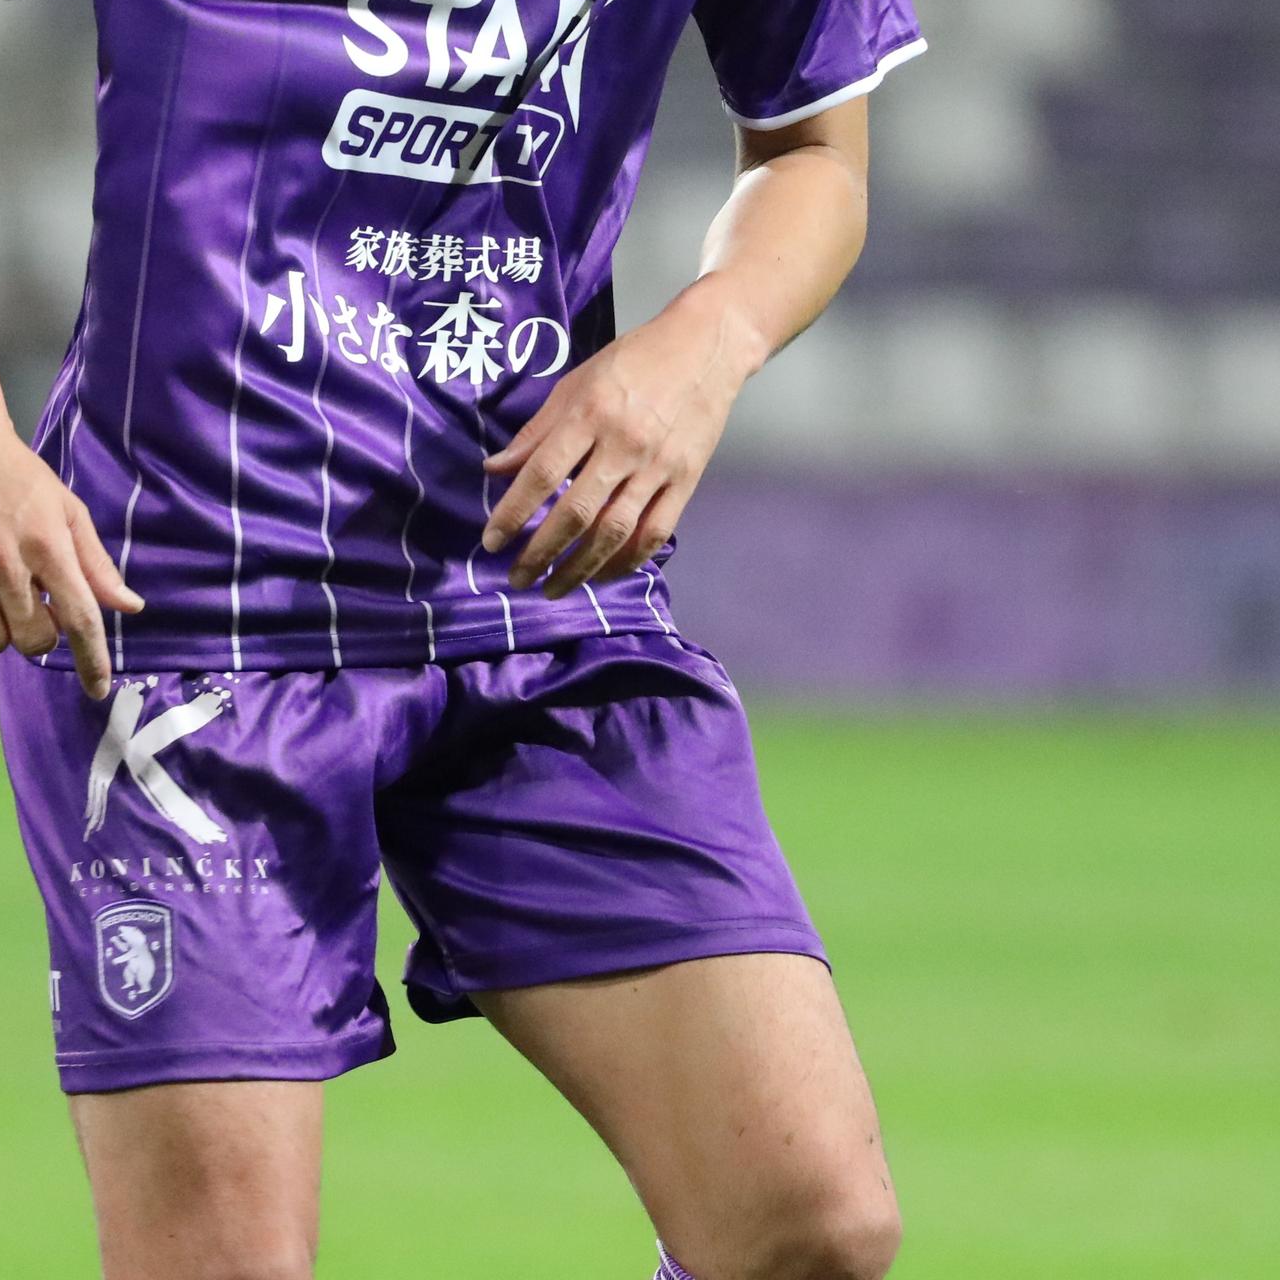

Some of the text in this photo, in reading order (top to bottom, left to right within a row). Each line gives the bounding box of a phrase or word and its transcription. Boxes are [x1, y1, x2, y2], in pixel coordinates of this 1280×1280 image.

[344, 225, 544, 283] 家族葬式場
[260, 271, 570, 385] 小さな森の
